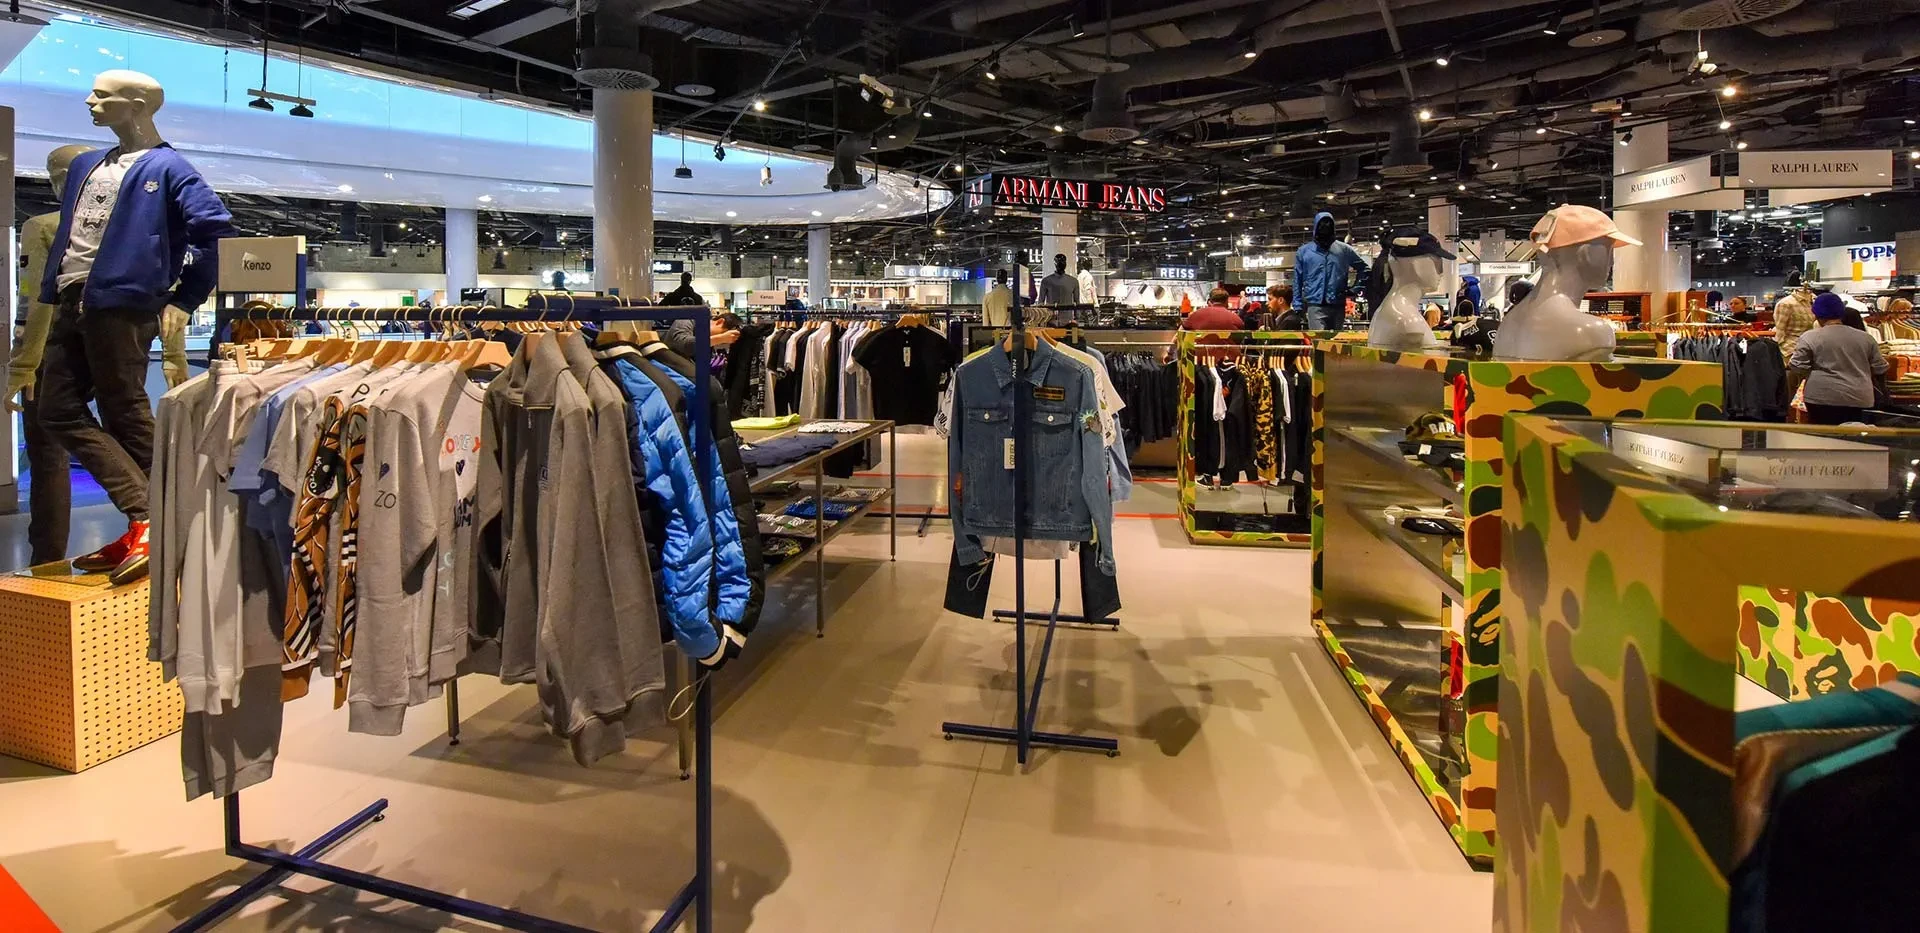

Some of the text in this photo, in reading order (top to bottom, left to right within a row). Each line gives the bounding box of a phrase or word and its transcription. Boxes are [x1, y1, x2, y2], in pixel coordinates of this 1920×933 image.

[1771, 162, 1859, 174] RALPH LAUREN
[1630, 173, 1687, 193] RALPH LAUREN
[994, 176, 1166, 212] ARMANI JEANS
[243, 259, 272, 271] Kenzo
[1242, 256, 1284, 269] Barbour
[1160, 268, 1195, 279] REISS
